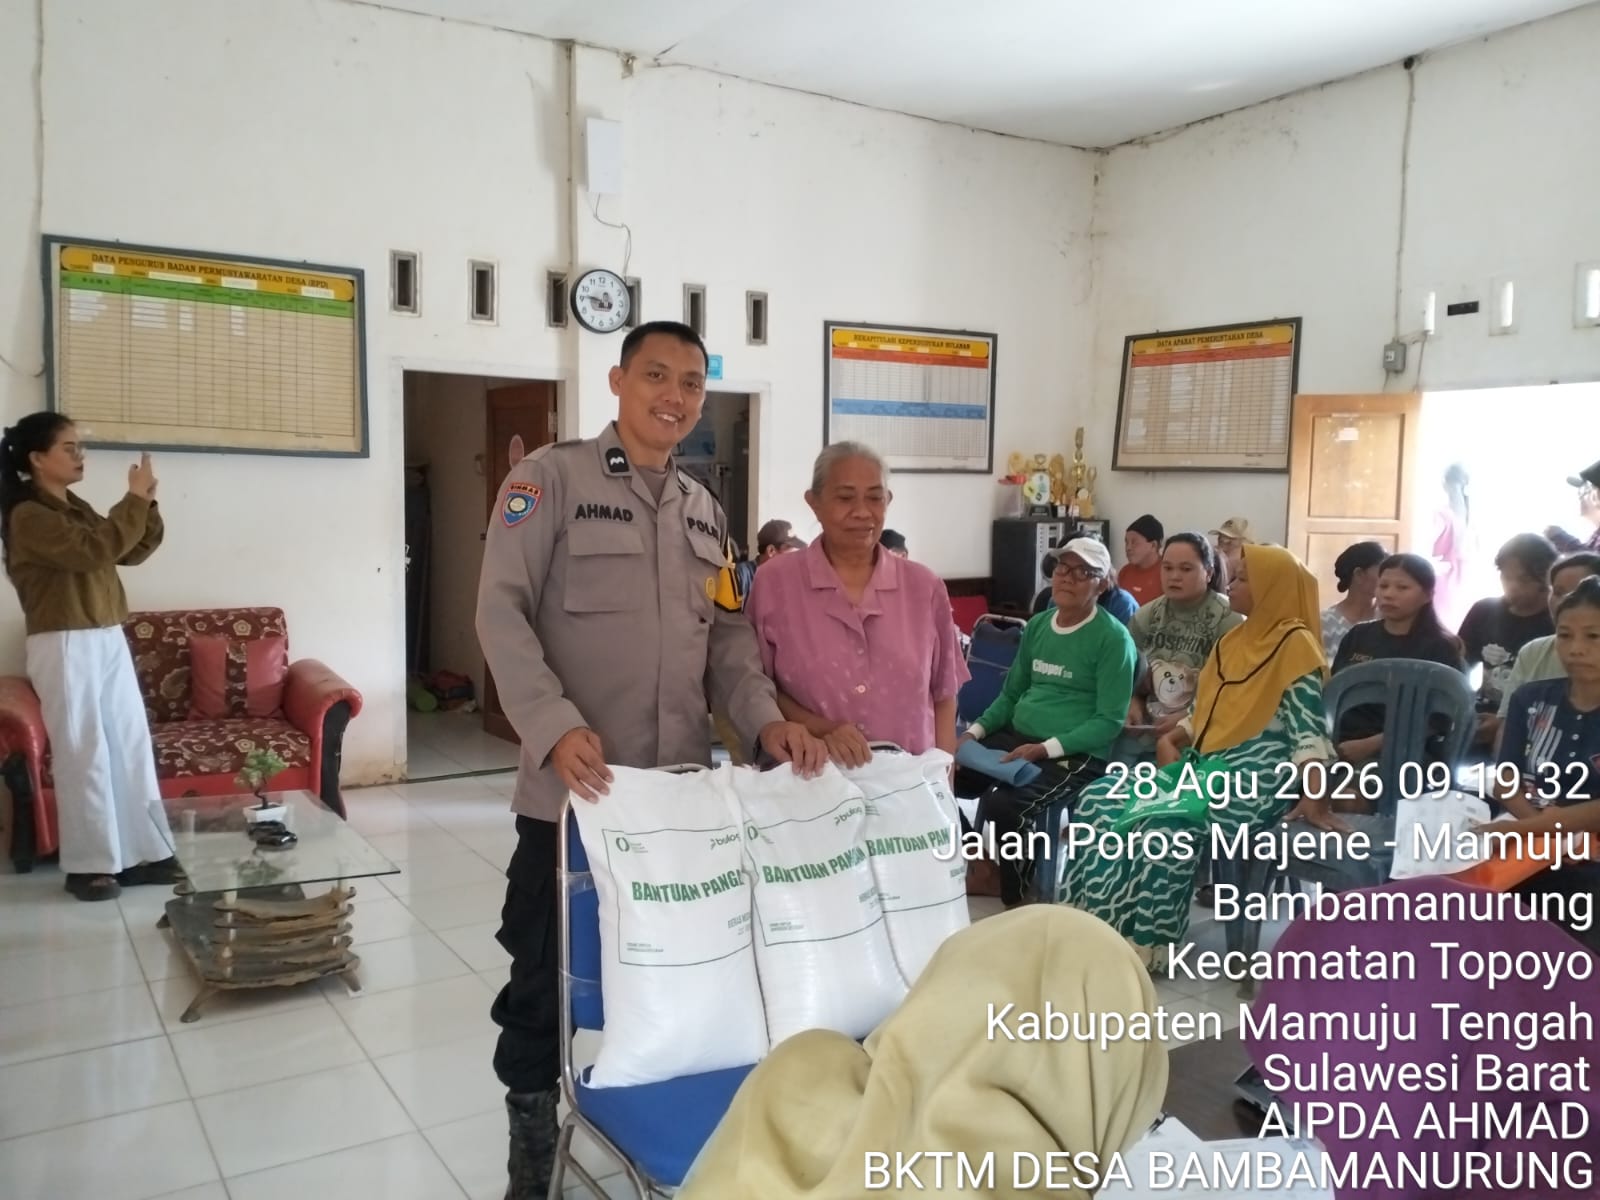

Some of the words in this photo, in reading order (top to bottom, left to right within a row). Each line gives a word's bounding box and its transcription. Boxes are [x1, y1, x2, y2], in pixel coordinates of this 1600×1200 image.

[92, 252, 116, 263] DATA
[118, 255, 165, 269] PENGURUS
[167, 261, 196, 273] BADAN
[285, 276, 306, 286] DESA
[575, 504, 634, 522] AHMAD
[865, 834, 929, 857] BANTUAN
[762, 862, 830, 884] BANTUAN
[632, 881, 702, 903] BANTUAN
